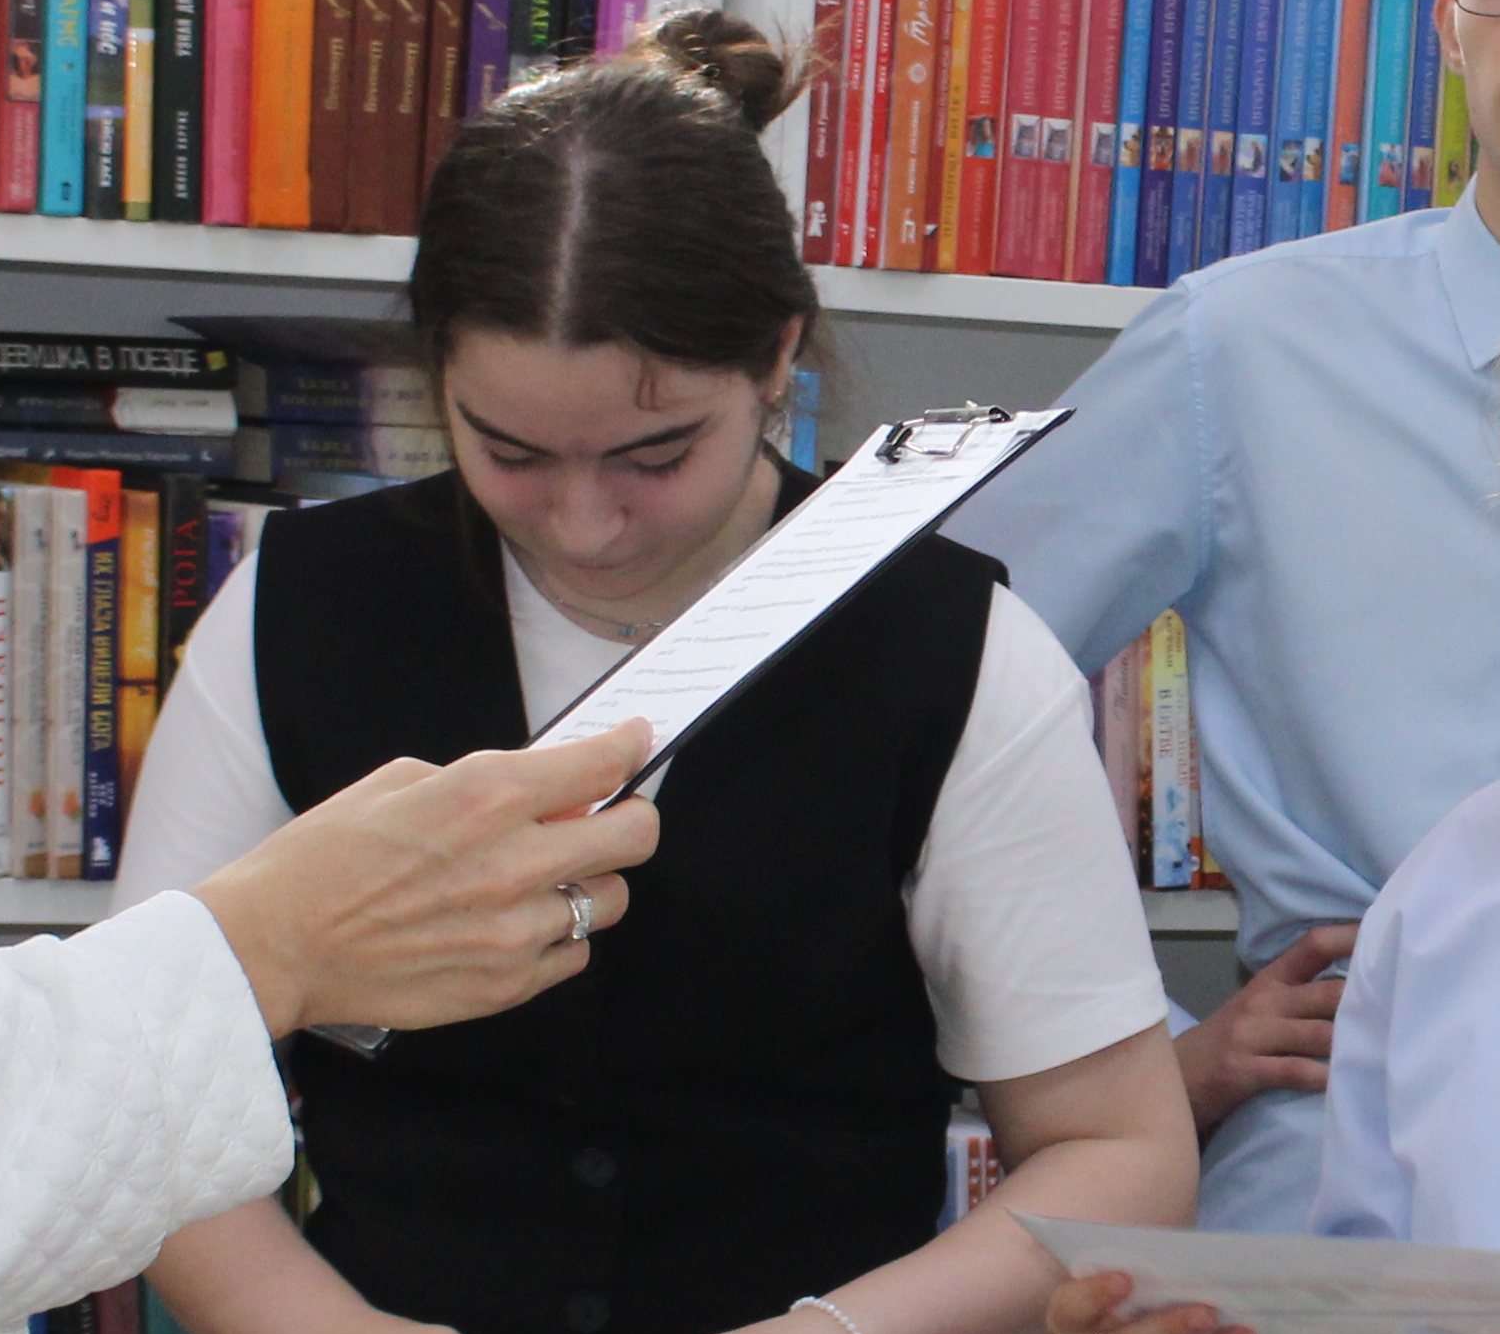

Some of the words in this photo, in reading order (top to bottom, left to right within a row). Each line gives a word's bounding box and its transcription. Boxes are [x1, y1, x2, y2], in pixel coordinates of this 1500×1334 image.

[97, 344, 113, 371] В
[119, 346, 200, 375] ПОЕЗДЕ
[95, 551, 117, 576] ИХ
[172, 518, 201, 609] РОГА
[93, 579, 115, 632] ГЛАЗА
[91, 634, 114, 705] ВИДЕЛИ
[89, 709, 113, 751] БОГА
